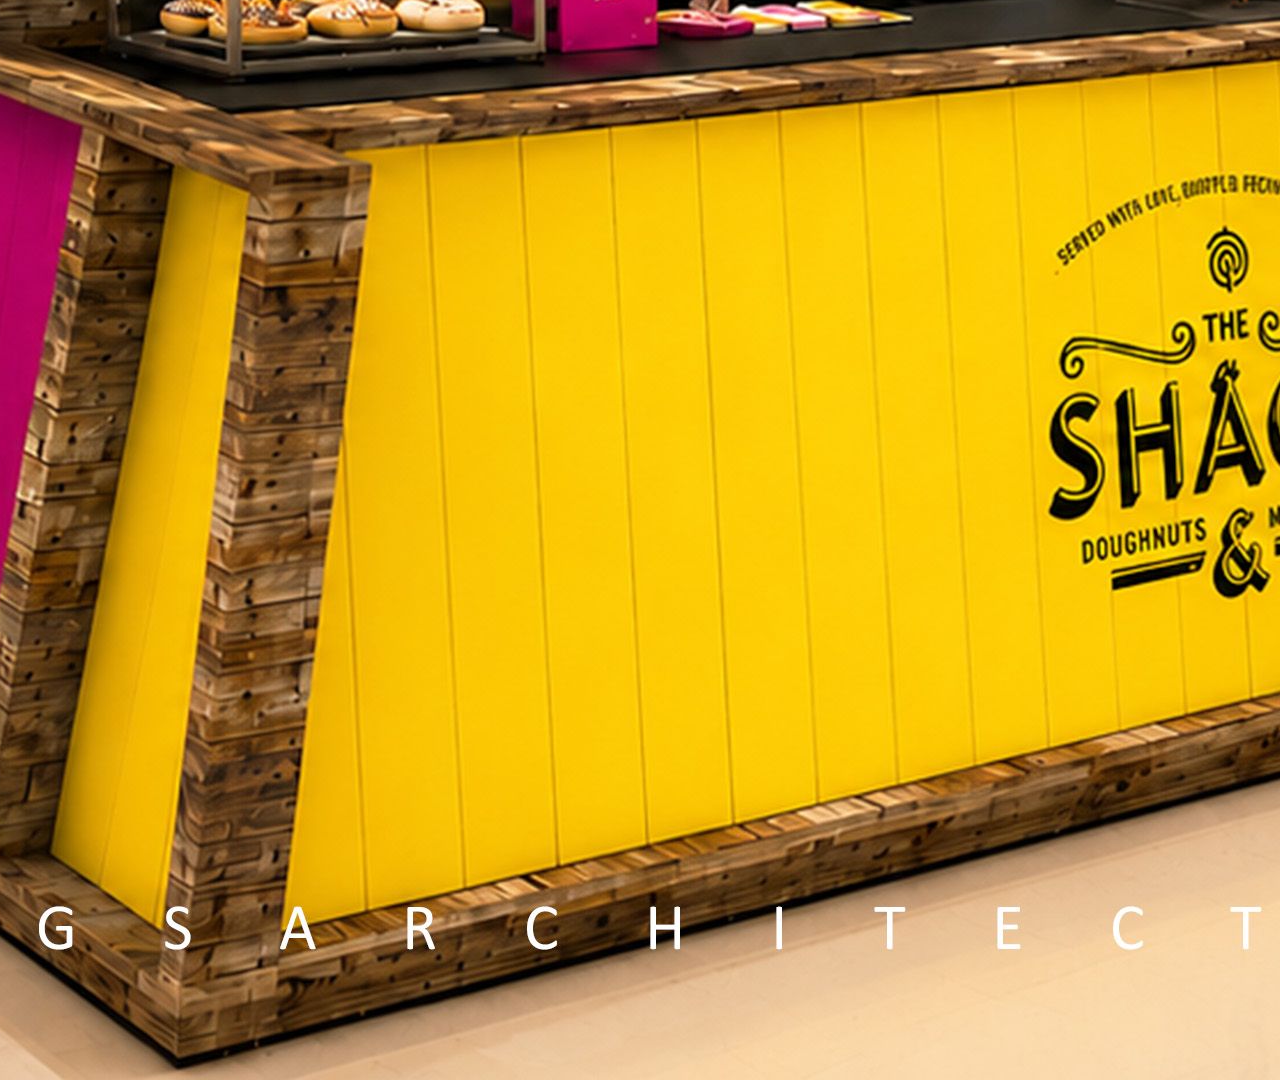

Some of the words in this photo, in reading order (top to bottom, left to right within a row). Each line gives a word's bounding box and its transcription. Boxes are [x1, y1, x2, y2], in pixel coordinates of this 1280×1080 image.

[1201, 307, 1249, 343] THE
[1081, 517, 1208, 565] DOUGHNUTS
[1213, 506, 1271, 599] &
